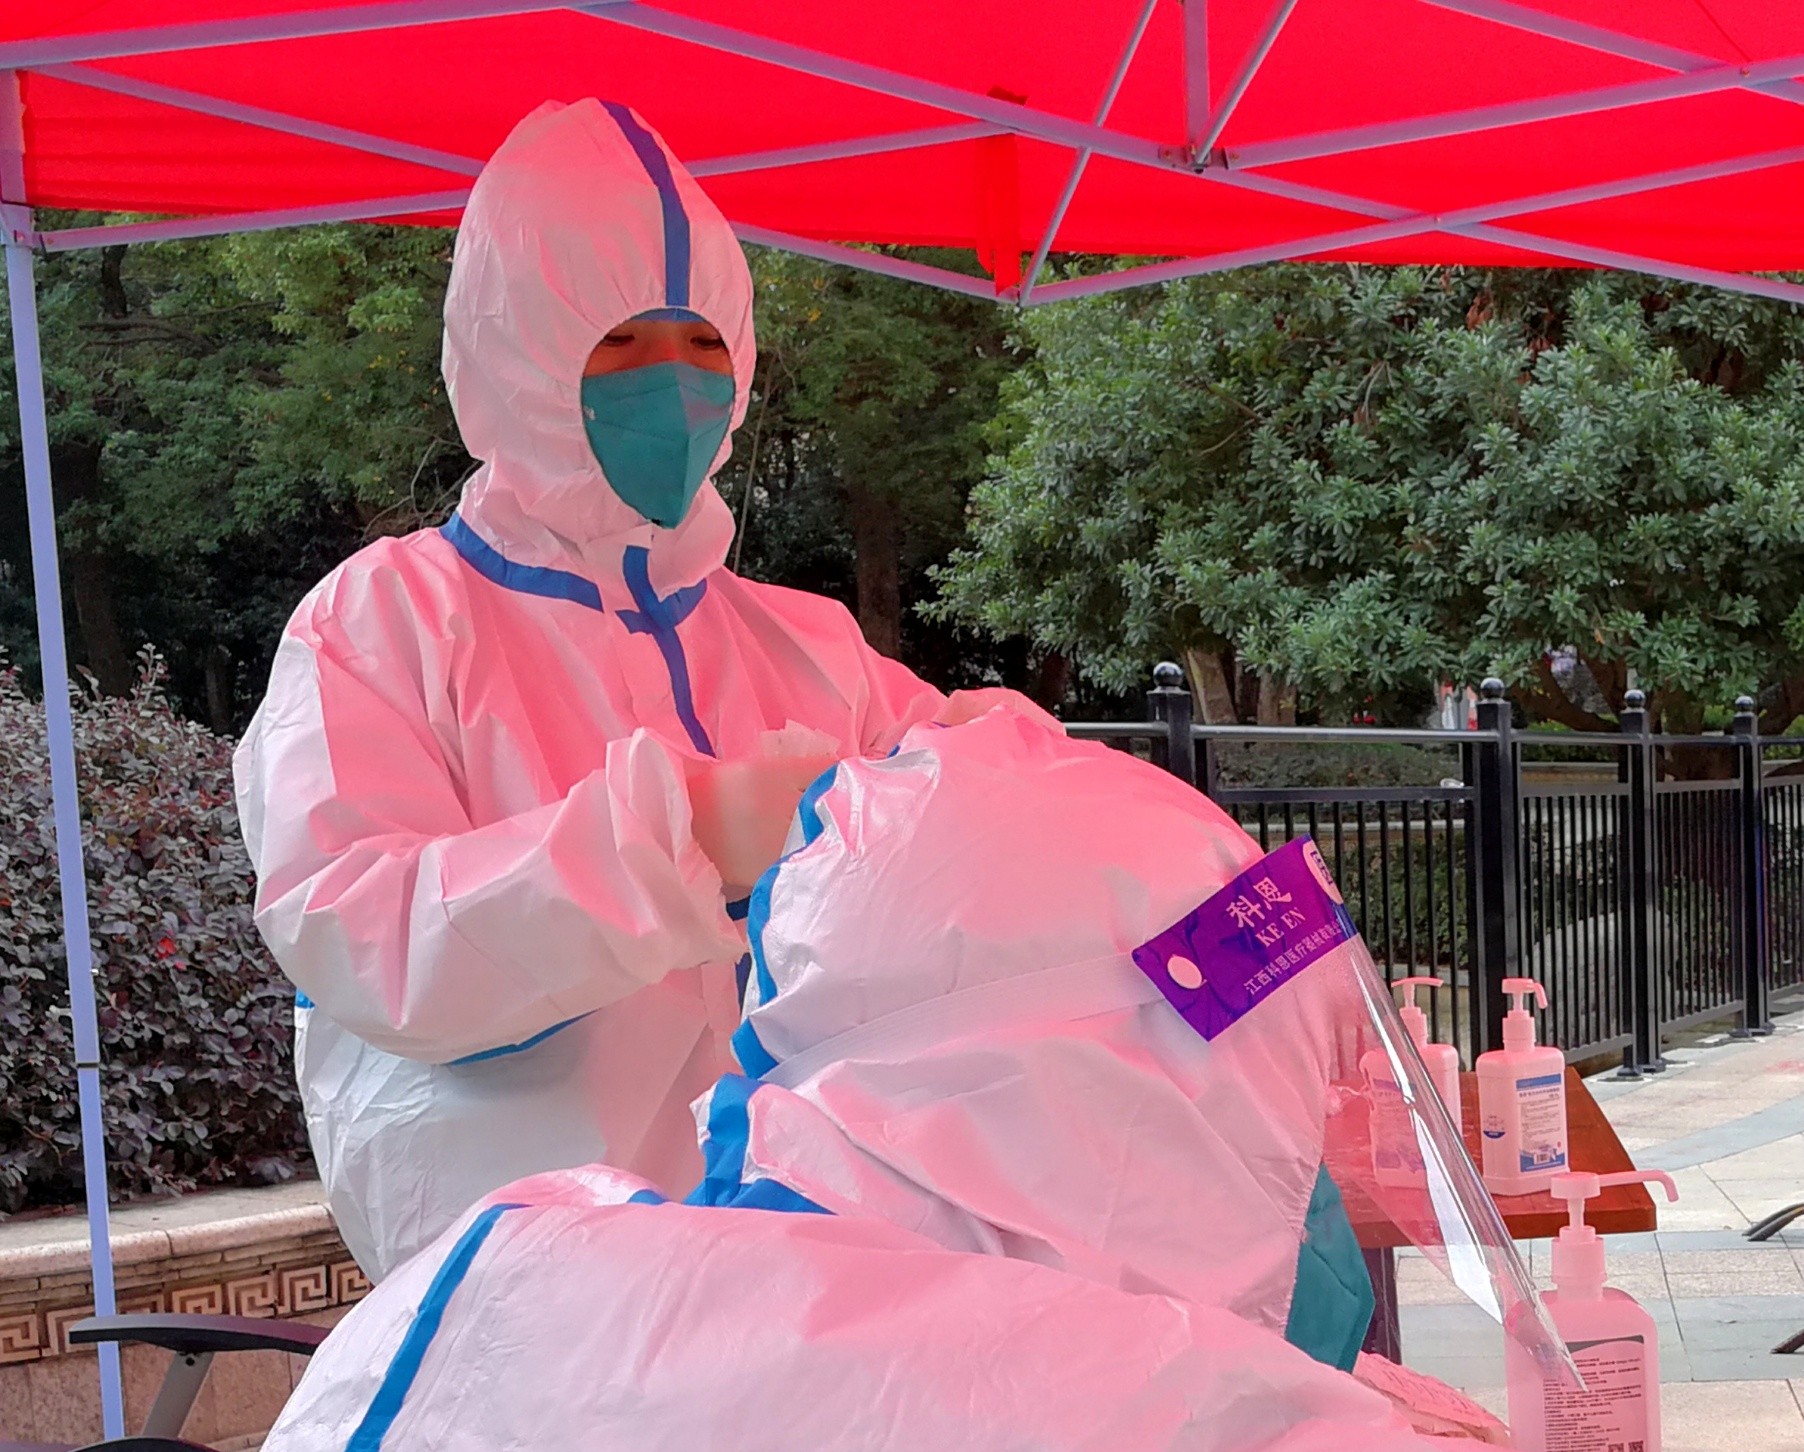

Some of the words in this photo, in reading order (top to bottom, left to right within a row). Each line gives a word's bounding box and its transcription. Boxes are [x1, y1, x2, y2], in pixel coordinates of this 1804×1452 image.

[1226, 877, 1292, 928] 科恩
[1255, 923, 1285, 947] KE
[1281, 907, 1306, 929] EN
